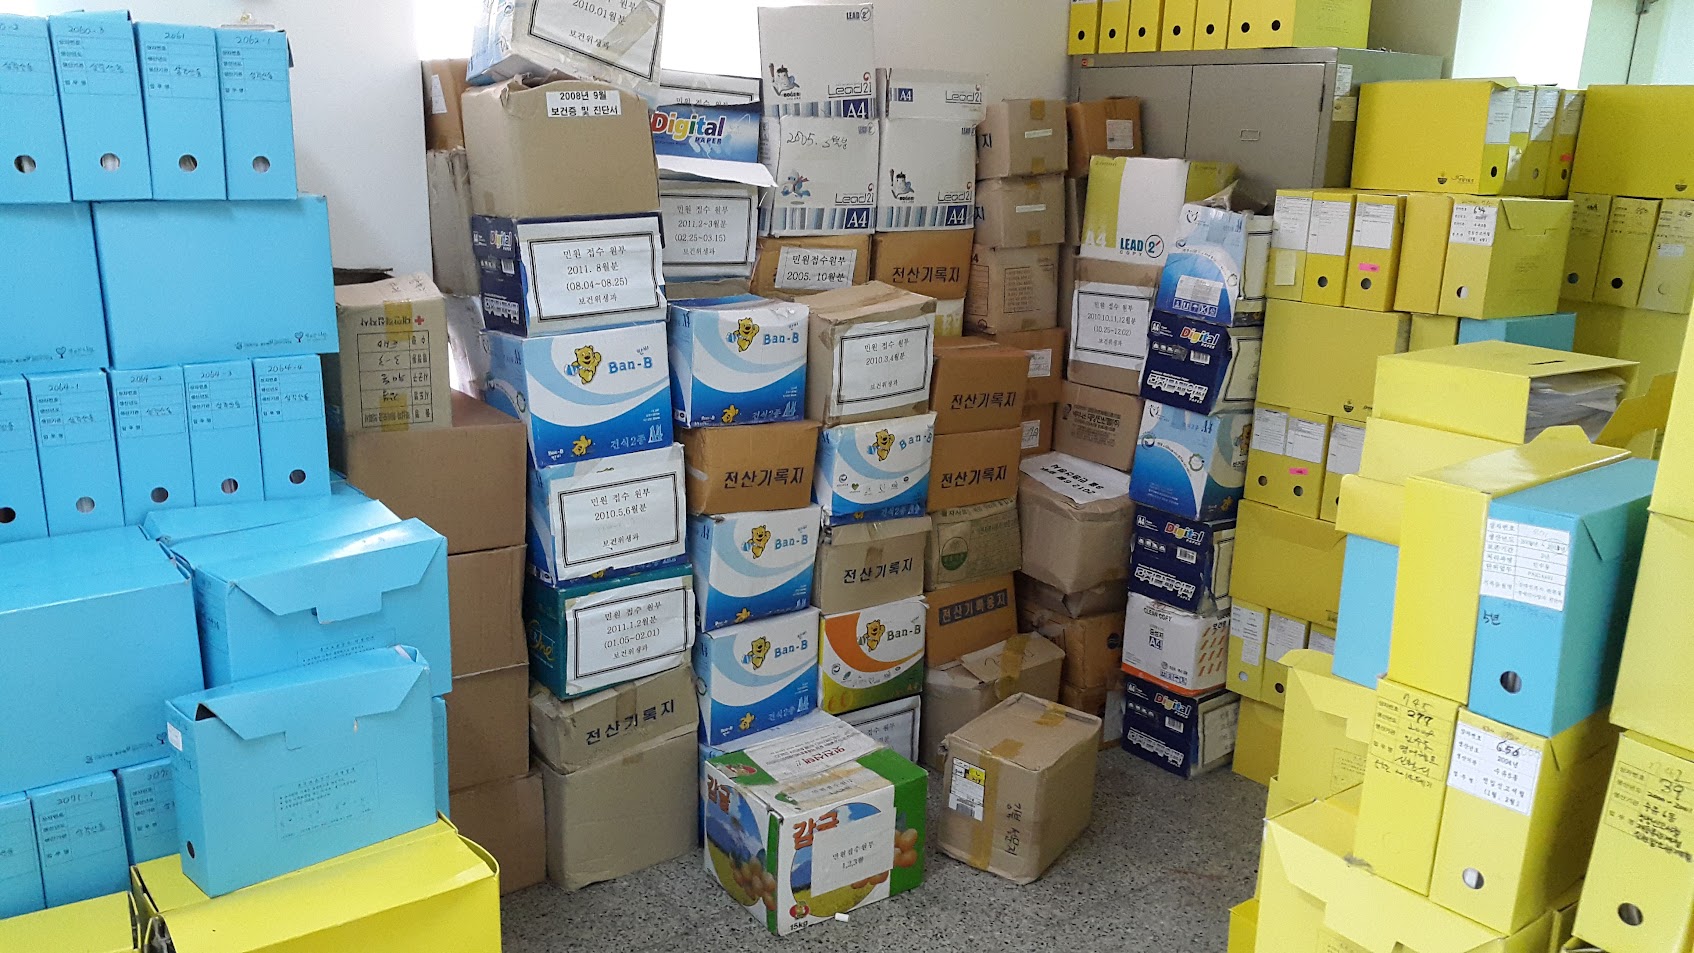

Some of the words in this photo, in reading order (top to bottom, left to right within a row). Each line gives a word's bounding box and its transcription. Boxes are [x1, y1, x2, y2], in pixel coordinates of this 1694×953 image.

[559, 92, 589, 101] 2008년
[593, 91, 608, 100] 9월
[899, 90, 913, 101] A4
[551, 107, 577, 117] 보건증
[593, 105, 619, 115] 진단서
[846, 101, 867, 118] A4
[652, 112, 726, 140] Digital
[848, 211, 868, 227] A4
[949, 210, 965, 225] A4
[563, 248, 582, 260] 민원
[587, 246, 605, 258] 접수
[609, 245, 627, 256] 원부
[1120, 237, 1144, 252] LEAD
[567, 264, 593, 275] 2011.
[596, 262, 620, 274] 8월분
[786, 271, 812, 282] 2005.
[816, 271, 846, 283] 10월분
[892, 266, 961, 284] 전산기록지
[763, 332, 800, 346] Ban-B
[1180, 326, 1220, 346] Digital
[608, 356, 653, 374] Ban-B
[951, 391, 1017, 410] 전산기록지
[899, 431, 934, 451] Ban-B
[724, 466, 804, 489] 전산기록지
[941, 465, 1008, 489] 전산기록지
[1164, 521, 1205, 543] Digital
[774, 533, 809, 551] Ban-B
[843, 557, 913, 585] 전산기록지
[1158, 612, 1172, 622] COPY
[886, 624, 921, 642] Ban-B
[774, 639, 808, 658] Ban-B
[1150, 636, 1163, 650] A4
[1154, 692, 1191, 714] Digital
[586, 699, 675, 746] 전산기록지
[1496, 740, 1521, 757] 656
[790, 921, 809, 931] 15kg
